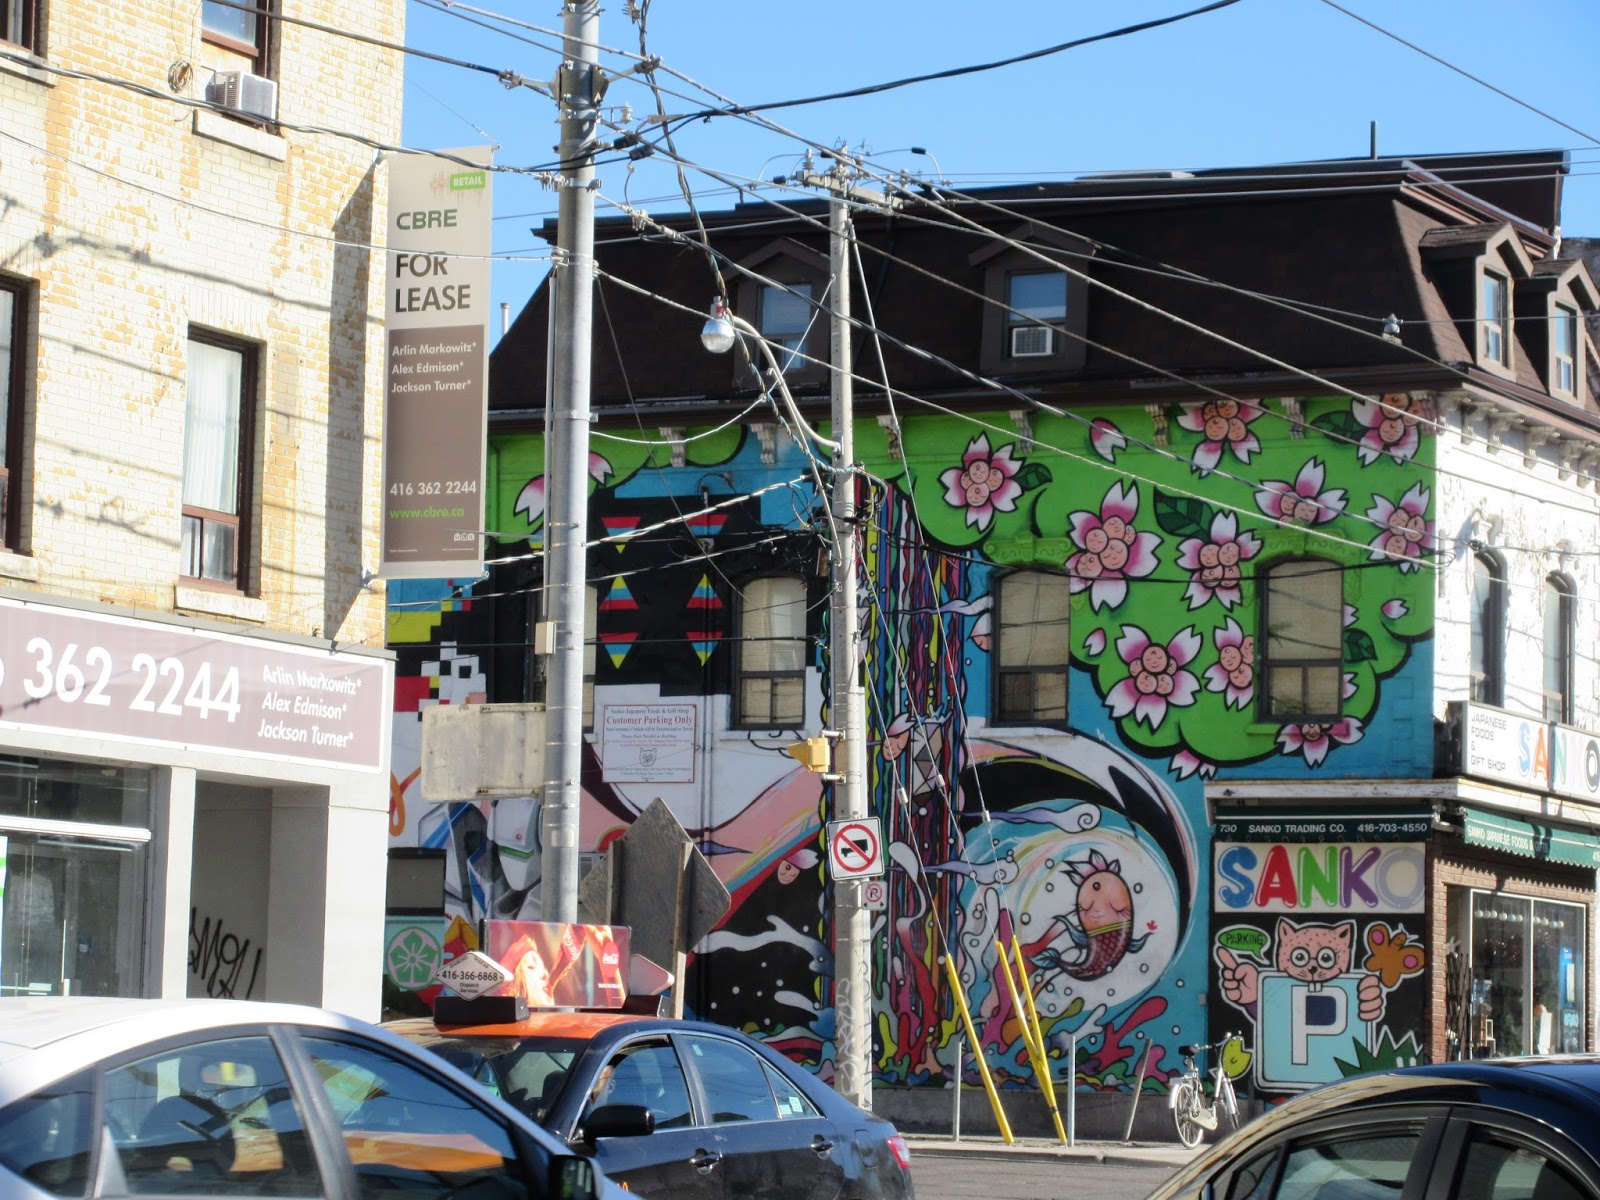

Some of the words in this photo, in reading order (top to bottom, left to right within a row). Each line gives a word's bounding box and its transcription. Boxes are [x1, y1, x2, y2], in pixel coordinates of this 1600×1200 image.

[453, 176, 483, 187] RETAIL
[396, 209, 458, 230] CBRE
[396, 251, 448, 278] FOR
[395, 284, 471, 313] LEASE
[392, 345, 416, 356] Arlin
[392, 364, 414, 375] Alex
[391, 382, 431, 393] Jackson
[390, 483, 413, 496] 416
[417, 482, 441, 495] 362
[445, 481, 477, 494] 2244
[389, 506, 465, 519] www.cbre.ca
[23, 637, 113, 706] 362
[129, 653, 241, 723] 2244
[263, 664, 294, 686] Arlin
[262, 691, 291, 713] Alex
[606, 716, 642, 725] Customer
[644, 715, 672, 726] Parking
[674, 715, 693, 726] Only
[1471, 712, 1507, 730] JAPANESE
[257, 718, 307, 743] Jackson
[1471, 726, 1495, 741] FOODS
[1471, 740, 1476, 751] &
[1471, 755, 1485, 767] GIFT
[1487, 758, 1506, 771] SHOP
[1220, 824, 1237, 833] 730
[1248, 824, 1281, 833] SANKO
[1285, 824, 1326, 833] TRADING
[1329, 823, 1346, 833] CO.
[1357, 823, 1428, 833] 416-703-4550
[1510, 836, 1529, 849] FOODS
[1218, 845, 1425, 909] SANKO
[1226, 933, 1264, 945] PARKING
[442, 970, 498, 981] 416-366-6868
[1291, 985, 1348, 1065] P
